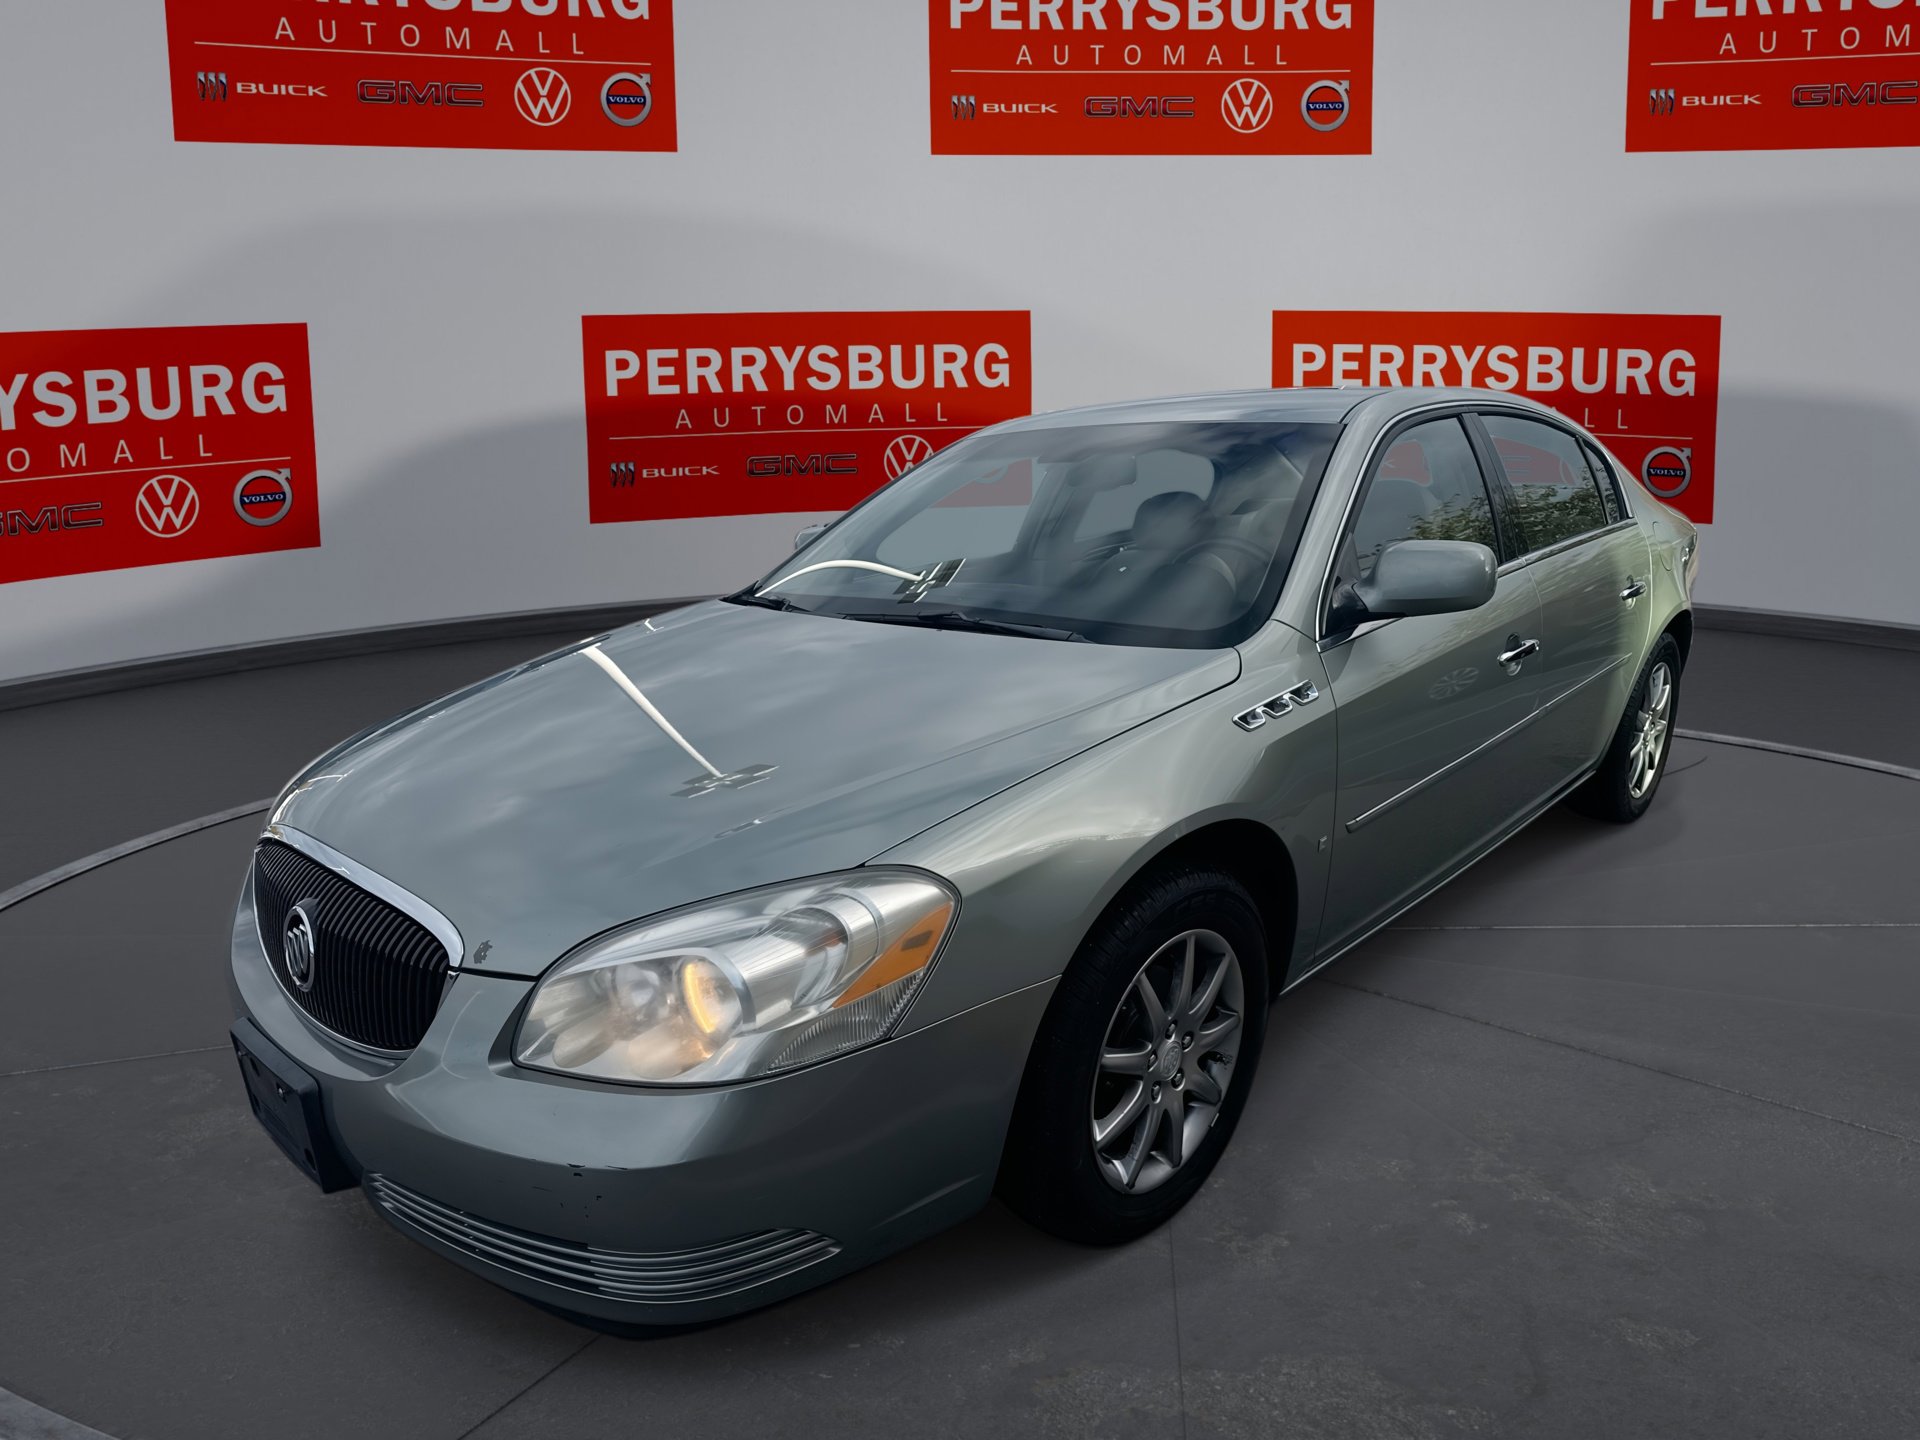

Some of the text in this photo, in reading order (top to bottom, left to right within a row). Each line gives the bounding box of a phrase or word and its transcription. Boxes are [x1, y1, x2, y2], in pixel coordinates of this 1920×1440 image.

[950, 0, 1352, 30] PERRYSBURG
[275, 17, 584, 54] AUTOMALL
[1016, 44, 1287, 65] AUTOMALL
[236, 82, 328, 97] BUICK
[356, 79, 484, 107] GMC
[608, 96, 645, 105] VOLVO
[982, 103, 1058, 114] BUICK
[1083, 95, 1195, 118] GMC
[1306, 102, 1343, 111] VOLVO
[1682, 80, 1919, 108] BUICK GMC
[605, 342, 1010, 397] PERRYSBURG
[1292, 343, 1696, 397] PERRYSBURG
[675, 402, 948, 429] AUTOMALL
[642, 465, 720, 478] BUICK
[746, 453, 858, 477] GMC
[1649, 468, 1685, 477] VOLVO
[0, 502, 104, 537] MC
[243, 493, 285, 504] VOLVO
